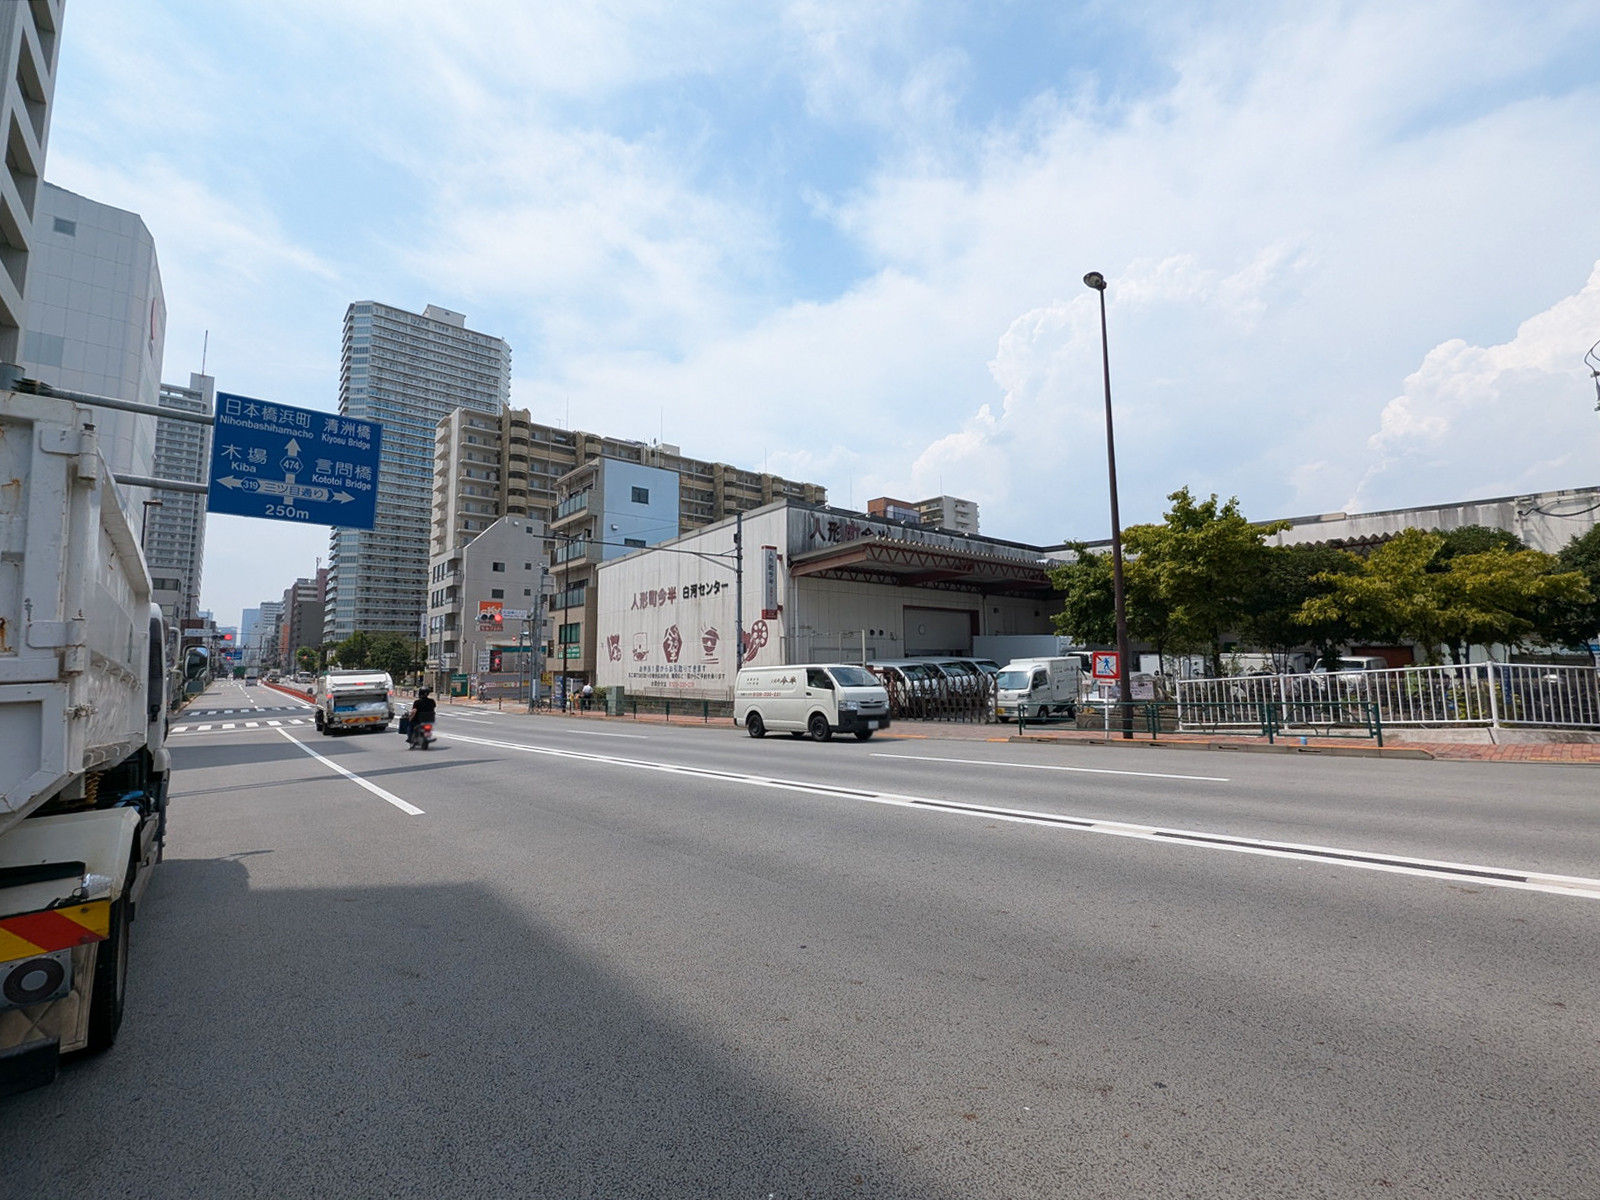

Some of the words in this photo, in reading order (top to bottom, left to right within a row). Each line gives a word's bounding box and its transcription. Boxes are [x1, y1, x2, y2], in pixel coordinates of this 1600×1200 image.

[225, 398, 312, 428] 日本橋浜町
[219, 414, 314, 439] Nihonbashihamacho
[323, 417, 372, 440] 清洲橋
[321, 433, 346, 446] Kiyosu
[347, 438, 371, 450] Bridge
[220, 443, 268, 465] 木場
[231, 461, 257, 474] Kiba
[283, 459, 299, 470] 474
[315, 458, 373, 481] 言問橋
[243, 479, 259, 490] 319
[263, 481, 324, 499] 三ツ目通り
[312, 473, 343, 486] Kototoi
[345, 479, 372, 491] Bridge
[265, 504, 309, 520] 250m
[631, 586, 677, 611] 人形町今半
[682, 580, 729, 599] 白河センター
